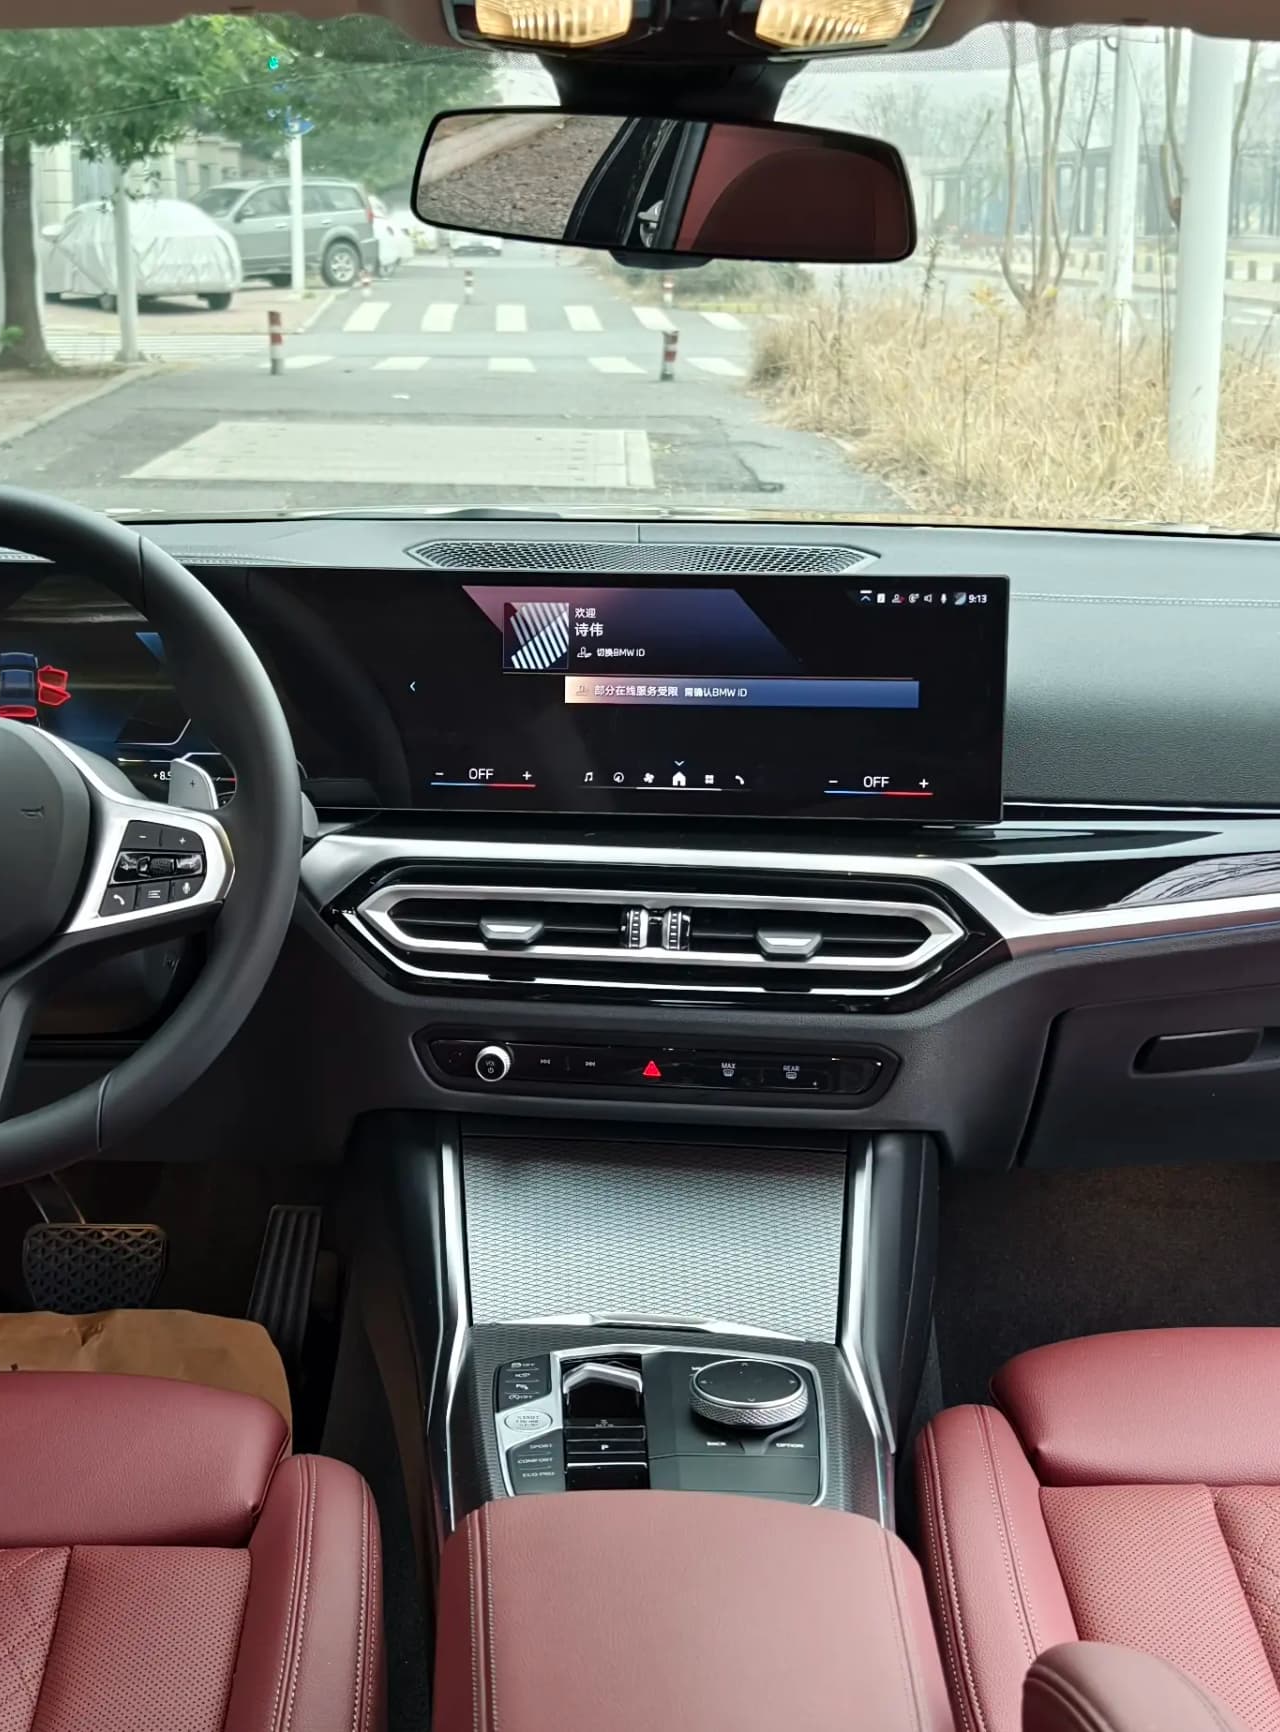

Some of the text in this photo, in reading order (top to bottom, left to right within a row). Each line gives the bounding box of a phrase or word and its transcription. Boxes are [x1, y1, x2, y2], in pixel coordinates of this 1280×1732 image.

[968, 594, 987, 604] 9:13
[574, 608, 596, 619] 欢迎
[574, 622, 604, 637] 诗伟
[594, 685, 678, 697] 部分在线服务受限
[468, 768, 494, 780] OFF
[863, 775, 890, 788] OFF
